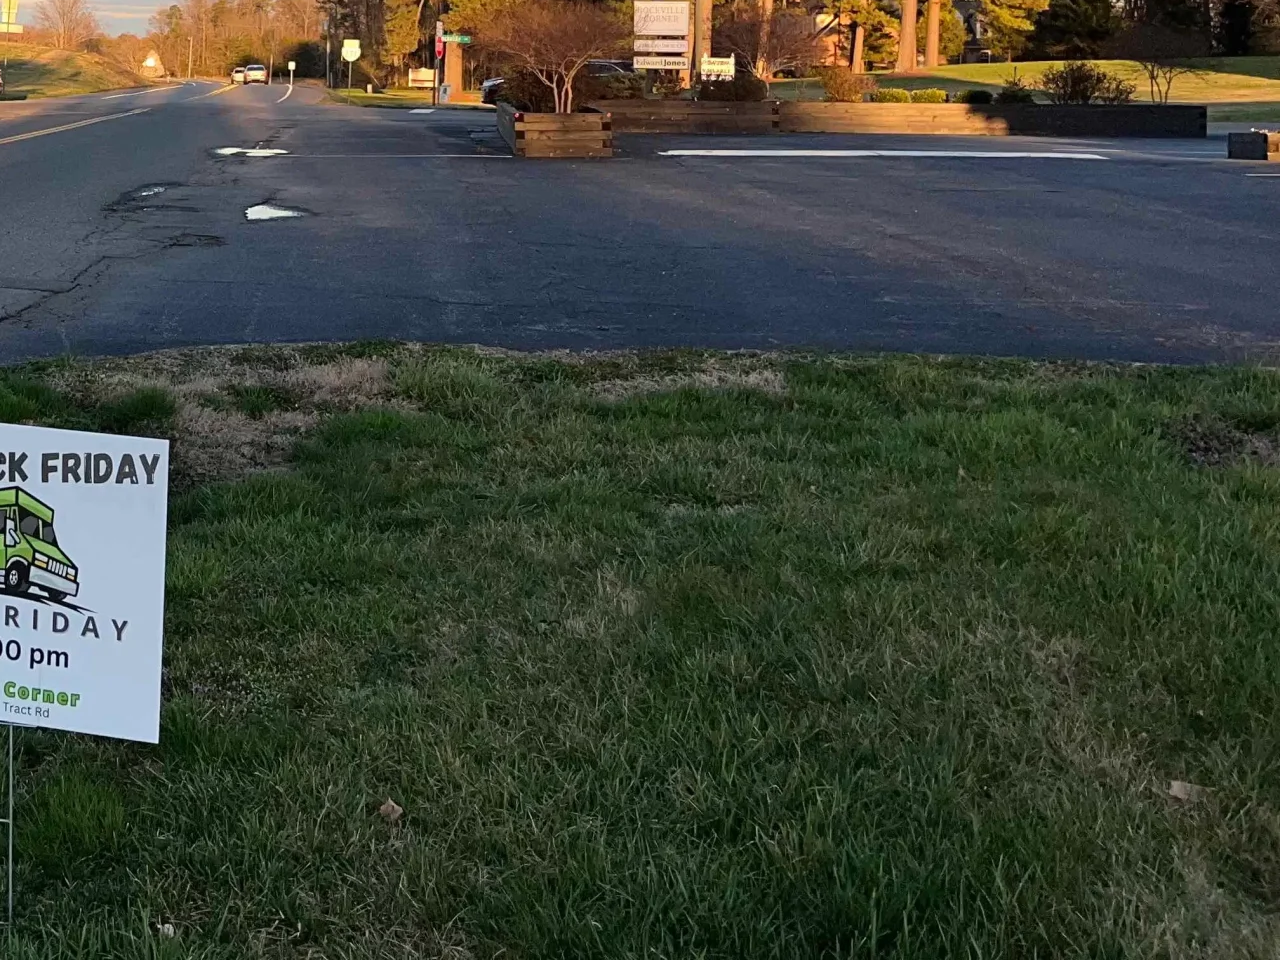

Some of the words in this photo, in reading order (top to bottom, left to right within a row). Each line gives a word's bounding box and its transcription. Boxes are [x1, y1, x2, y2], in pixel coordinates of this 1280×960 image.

[636, 58, 663, 66] Edward
[663, 59, 687, 67] Jones
[41, 452, 161, 485] FRIDAY
[30, 646, 70, 669] pm
[4, 681, 81, 708] Corner
[3, 701, 32, 717] Tract
[35, 705, 50, 718] Rd
